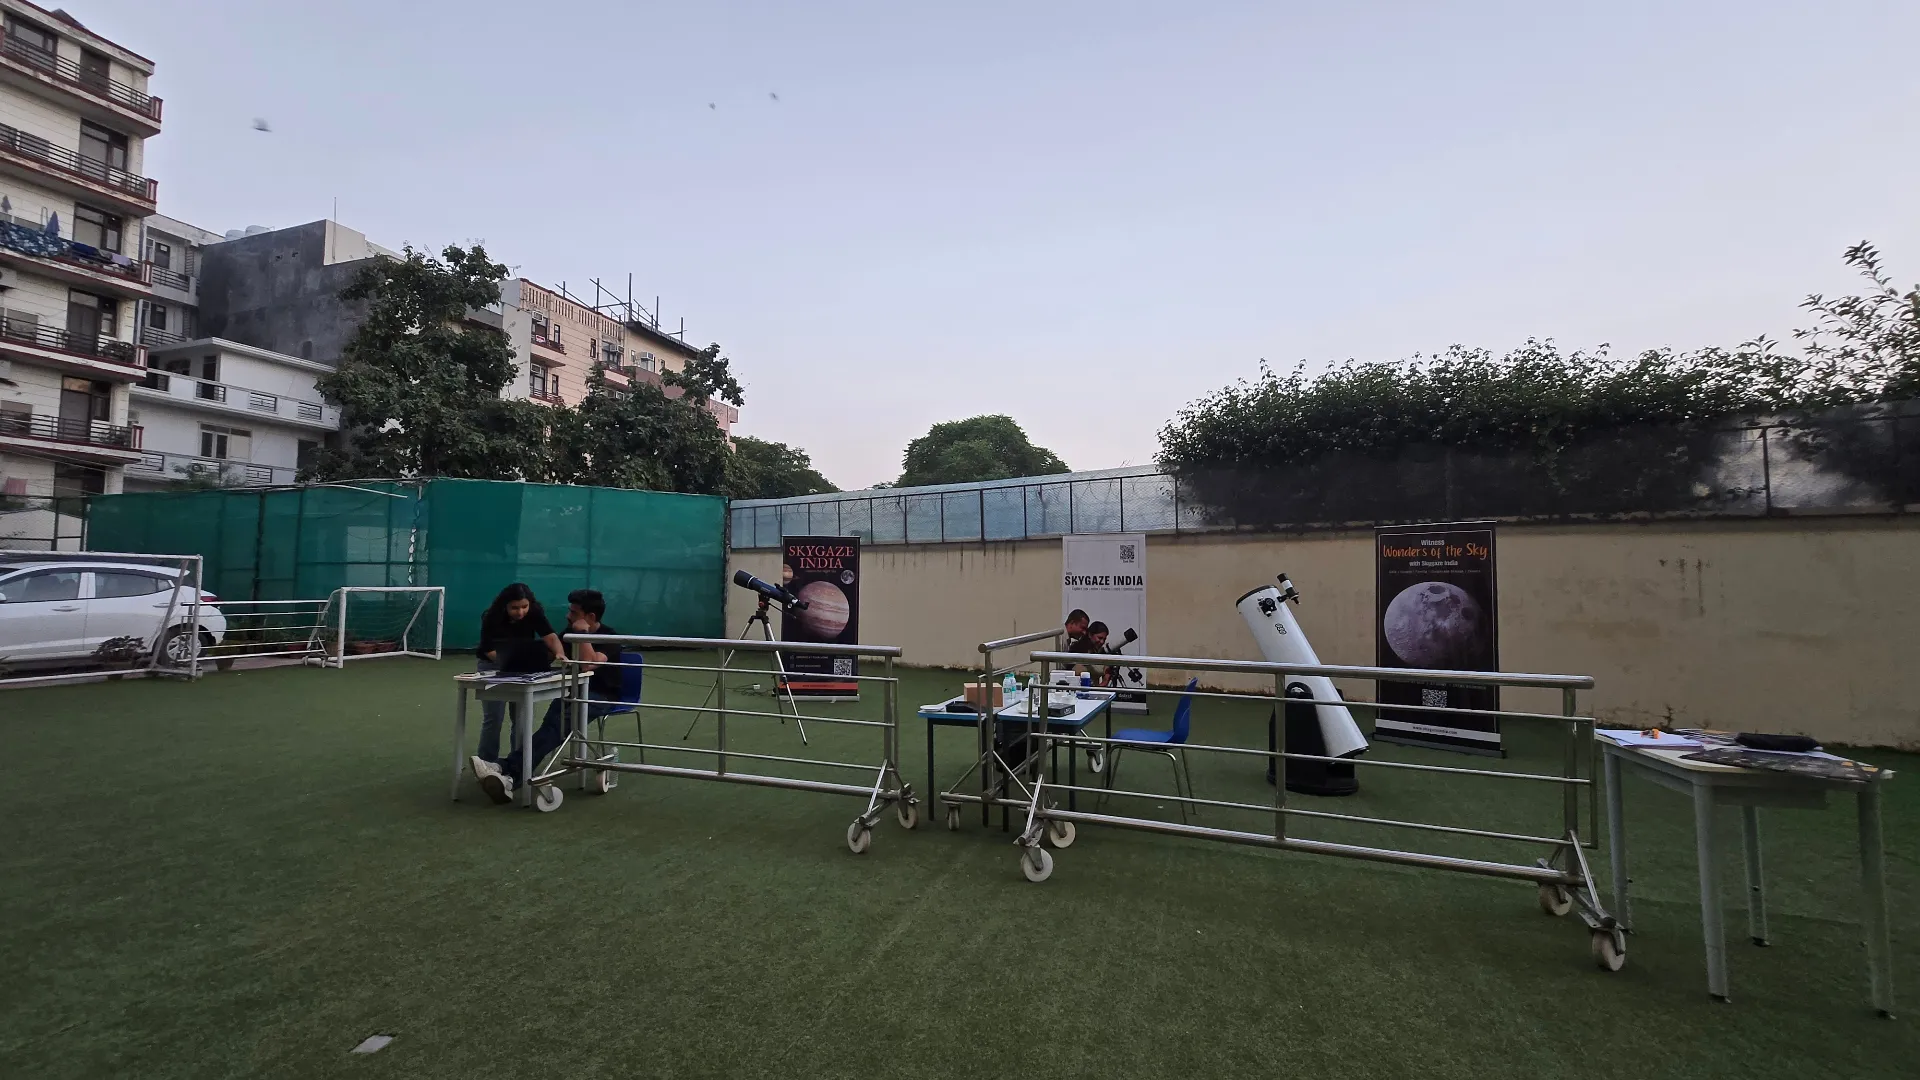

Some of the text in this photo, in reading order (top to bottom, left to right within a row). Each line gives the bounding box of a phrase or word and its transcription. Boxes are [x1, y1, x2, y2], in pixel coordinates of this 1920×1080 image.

[788, 545, 855, 557] SKYGAZE
[1430, 547, 1442, 559] of
[1446, 544, 1463, 557] the
[1466, 542, 1488, 560] Sky
[800, 557, 843, 569] INDIA
[1064, 575, 1144, 586] SKYGAZE INDIA
